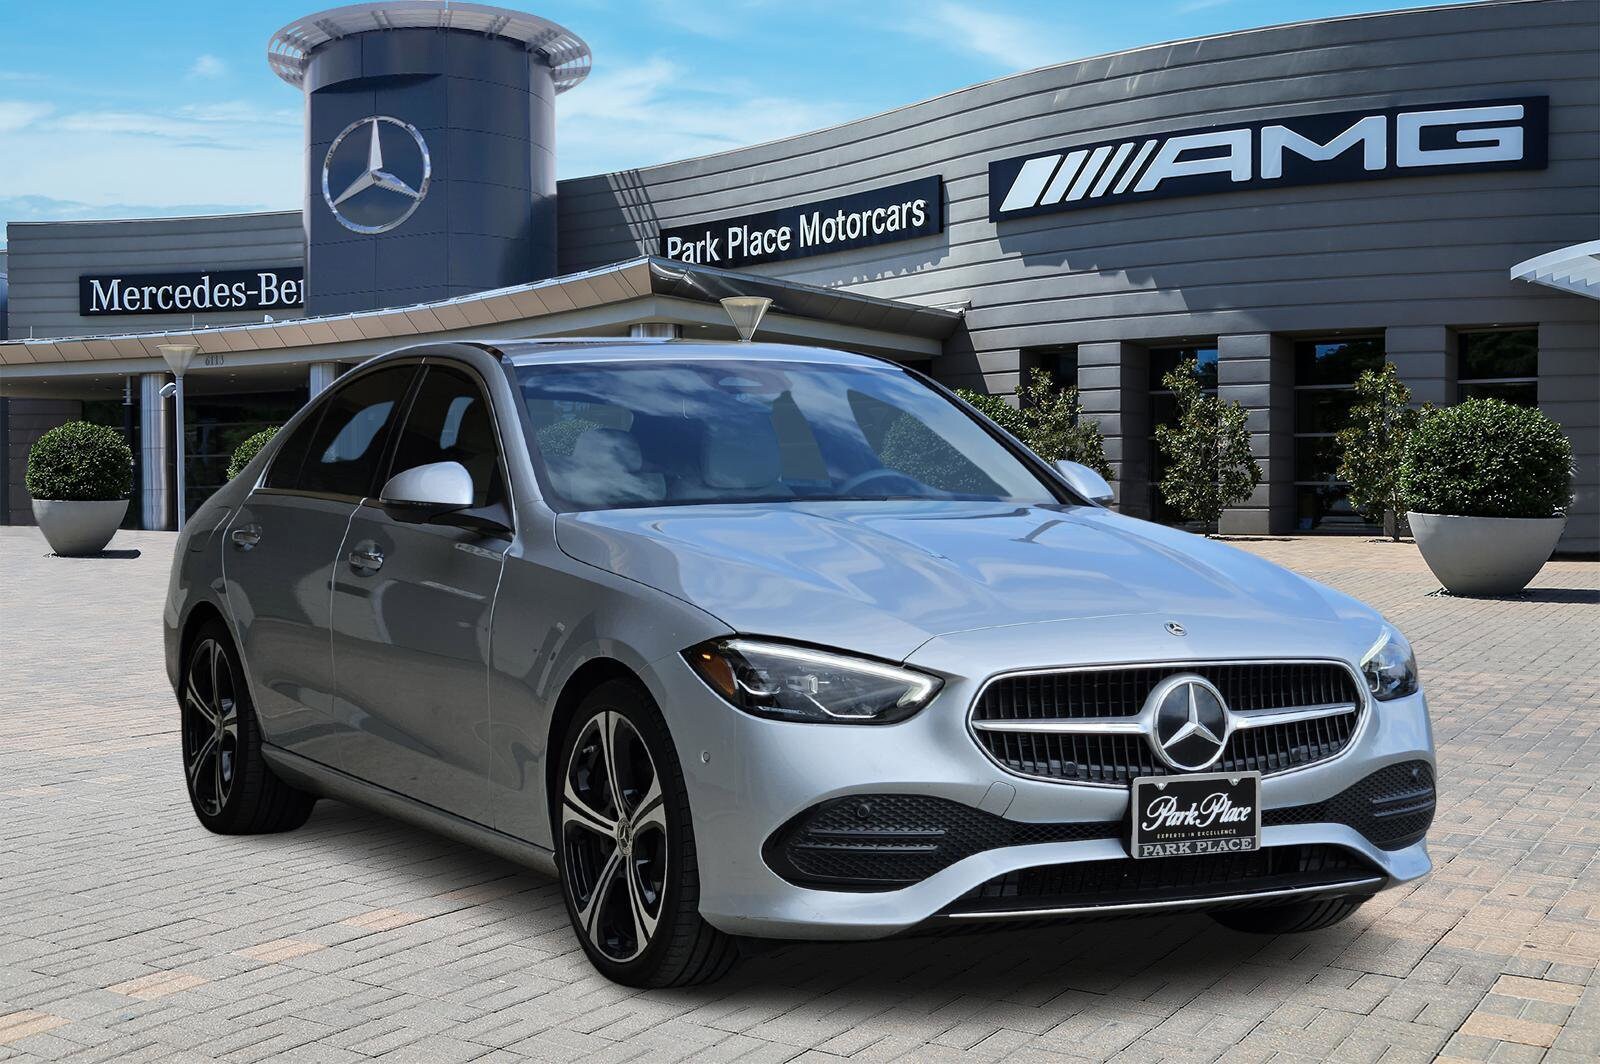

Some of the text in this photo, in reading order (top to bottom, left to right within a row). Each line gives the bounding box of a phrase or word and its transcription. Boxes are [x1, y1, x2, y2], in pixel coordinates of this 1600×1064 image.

[667, 198, 927, 264] Park Place Motorcars
[1141, 792, 1252, 831] Park Place
[1197, 828, 1236, 837] EXCELLENCE
[1142, 838, 1252, 857] PARK PLACE
